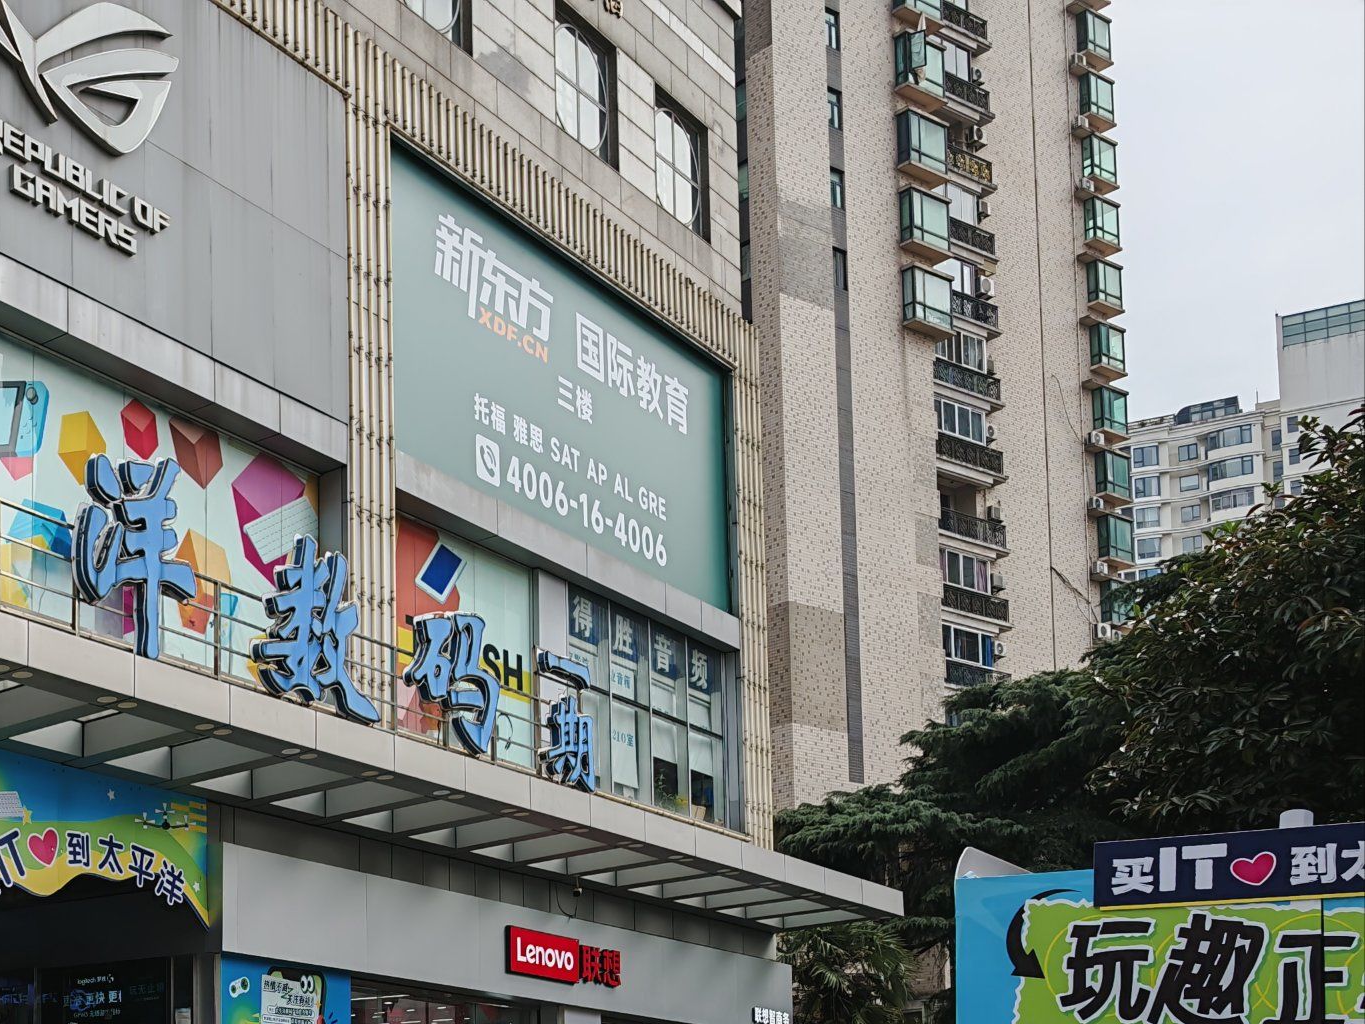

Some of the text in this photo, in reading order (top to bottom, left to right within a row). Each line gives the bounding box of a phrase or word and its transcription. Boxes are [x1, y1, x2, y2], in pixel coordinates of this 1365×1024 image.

[9, 163, 138, 256] GAMERS
[131, 195, 172, 235] OF
[434, 213, 690, 435] 新东方 国际教育
[478, 307, 549, 364] XDF.CN
[557, 376, 594, 425] 三楼
[474, 393, 667, 522] 托福 雅思 SAT AP AL GRE
[506, 455, 667, 567] 4006-16-4006
[66, 832, 185, 906] 到太平洋
[1110, 842, 1228, 896] 买IT
[516, 936, 621, 988] Lenovo 联想
